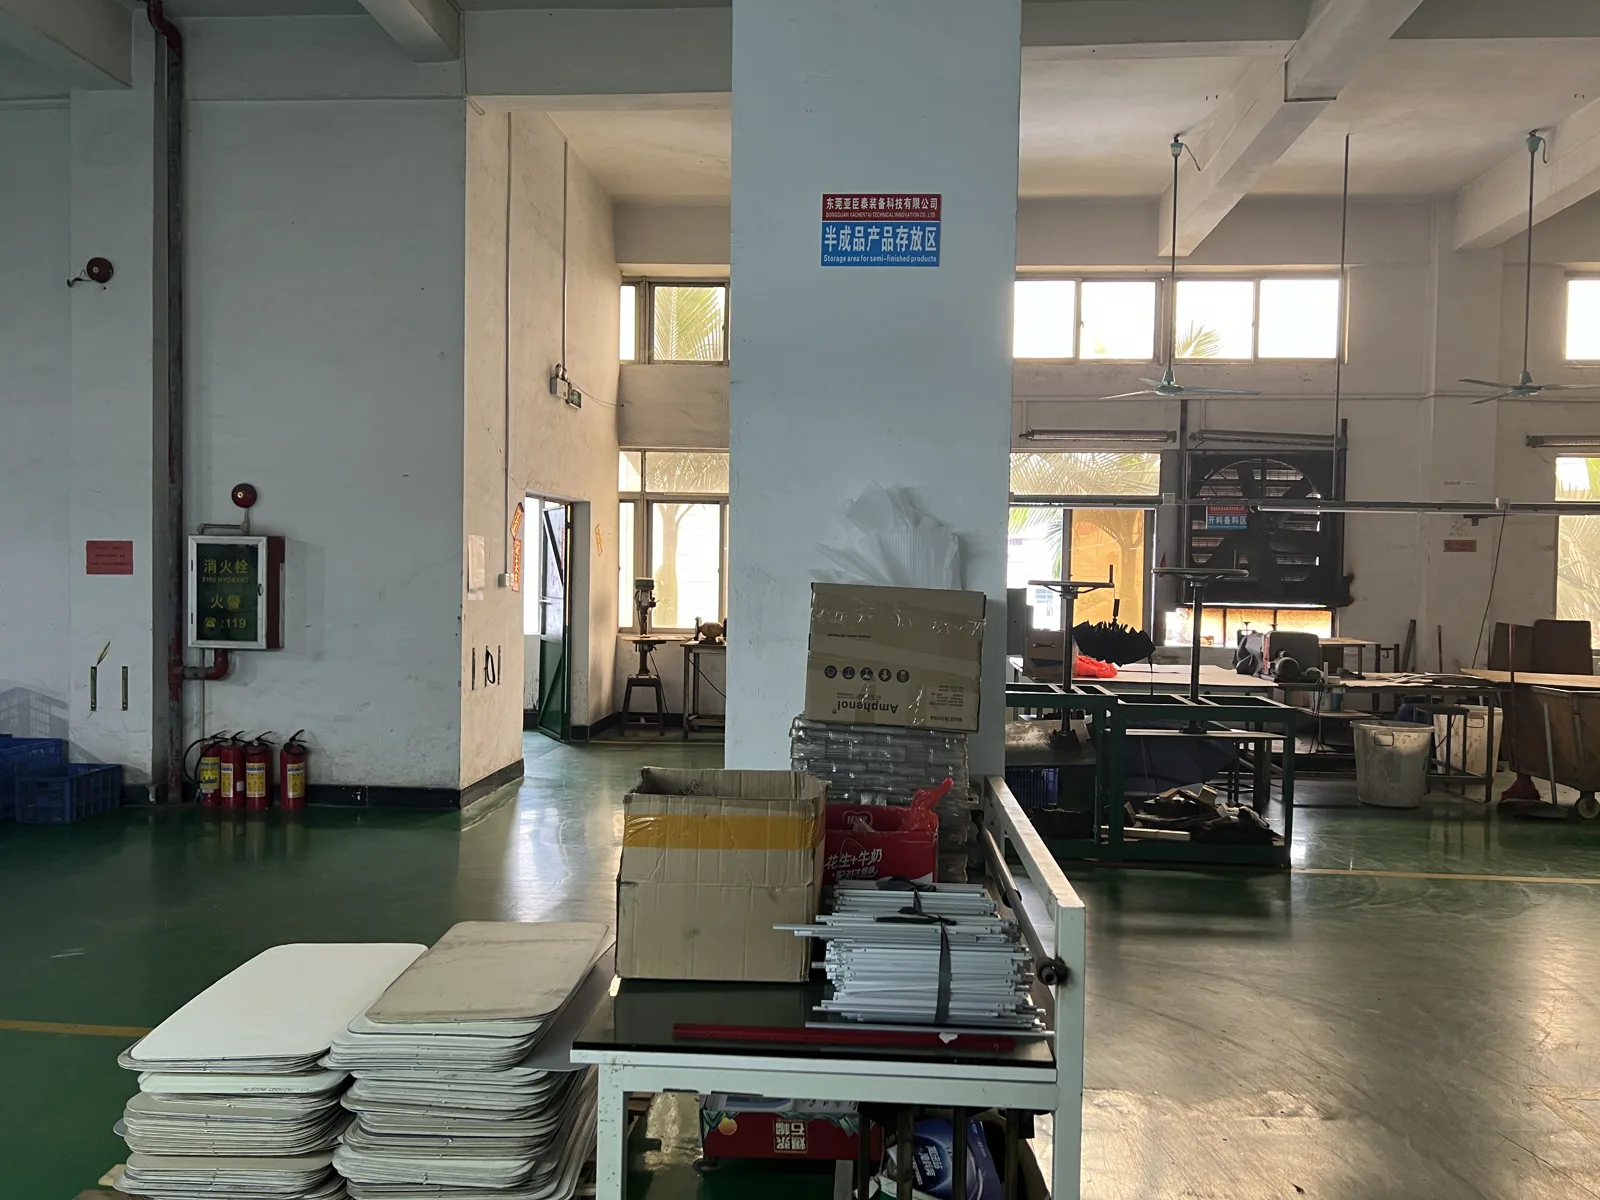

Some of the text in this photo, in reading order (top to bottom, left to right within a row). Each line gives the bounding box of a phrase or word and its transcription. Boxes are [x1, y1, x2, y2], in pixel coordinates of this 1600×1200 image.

[826, 197, 938, 210] 东莞亚臣泰装备科技有限公司
[824, 225, 937, 252] 半成品产品存放区
[823, 254, 847, 263] Storage
[860, 254, 869, 262] for
[869, 254, 910, 262] semi-finished
[910, 254, 937, 263] products
[1208, 515, 1247, 525] 开料备料区
[204, 559, 249, 574] 消火栓
[837, 700, 899, 714] Amphenol
[825, 848, 883, 870] 花生+牛奶
[775, 1136, 806, 1151] 爆浆
